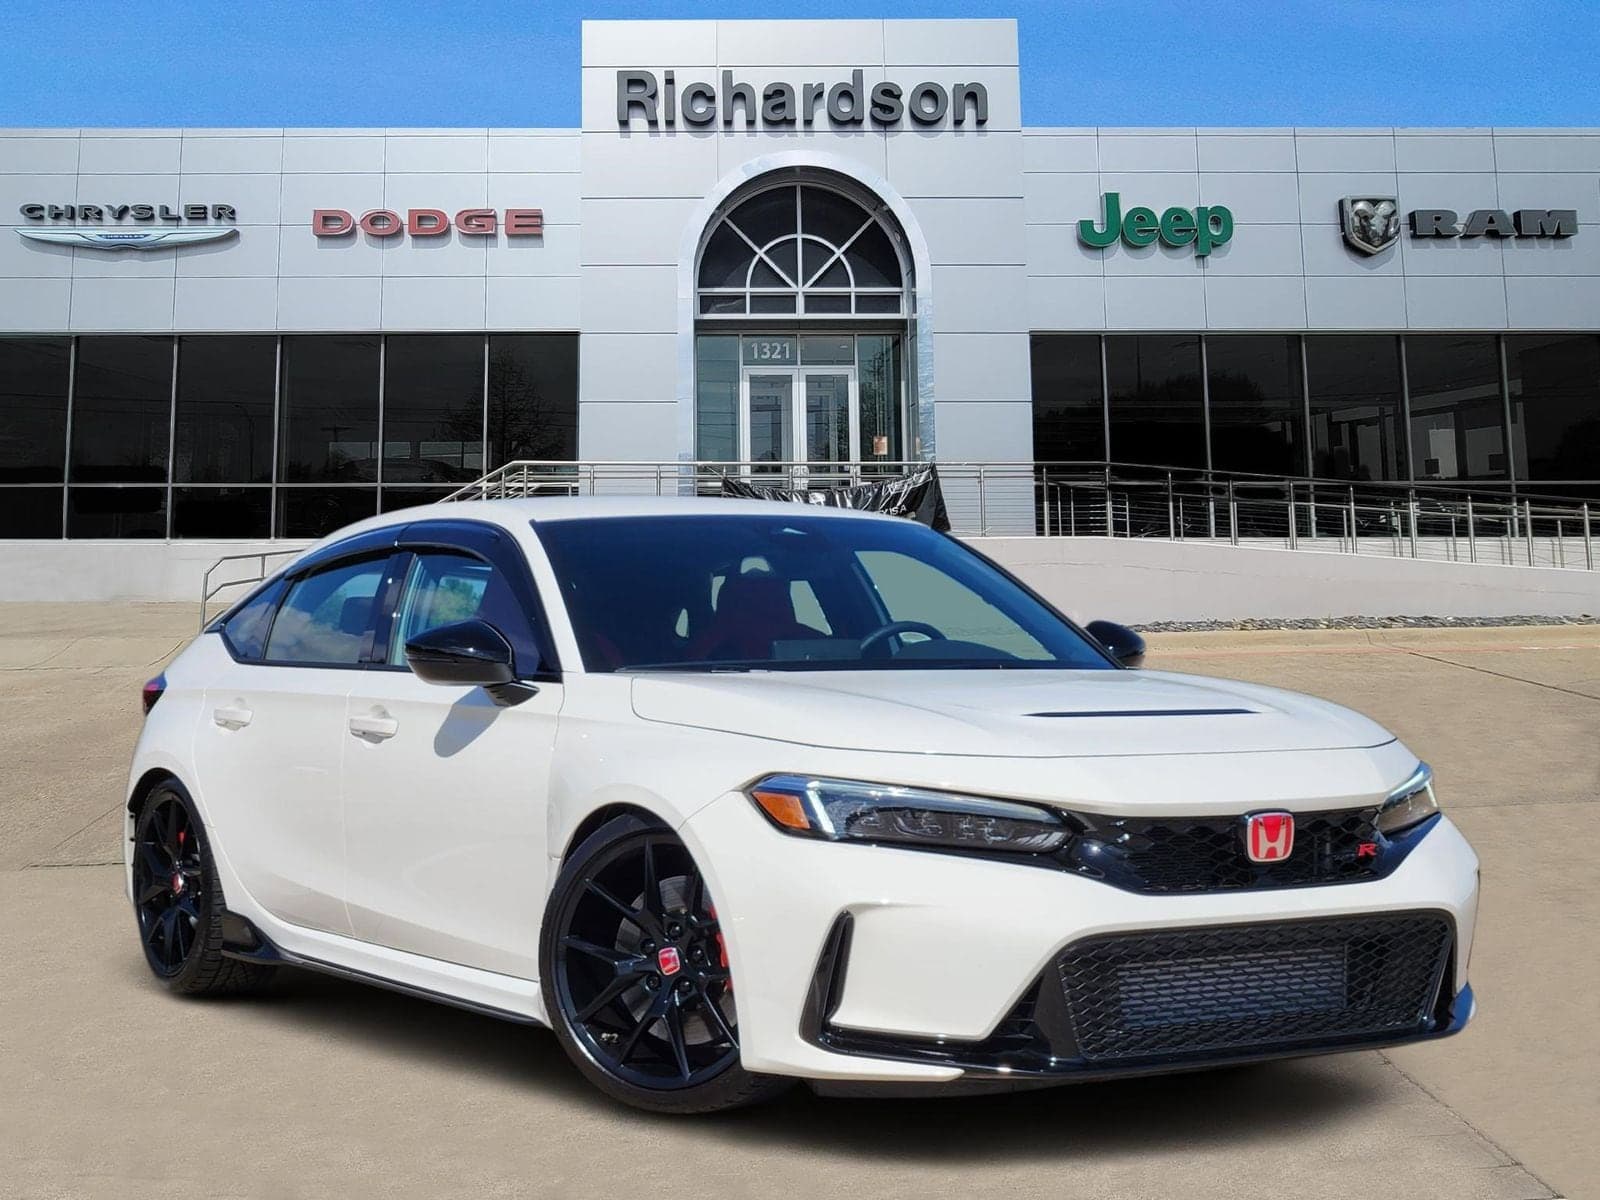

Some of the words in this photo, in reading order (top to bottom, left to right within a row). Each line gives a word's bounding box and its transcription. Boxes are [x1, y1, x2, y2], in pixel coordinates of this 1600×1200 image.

[616, 69, 989, 126] Richardson
[19, 203, 237, 221] CHRYSLER
[312, 208, 544, 236] DODGE
[1077, 192, 1234, 258] Jeep
[1408, 209, 1579, 239] RAM
[751, 342, 790, 359] 1321
[1358, 842, 1377, 857] R
